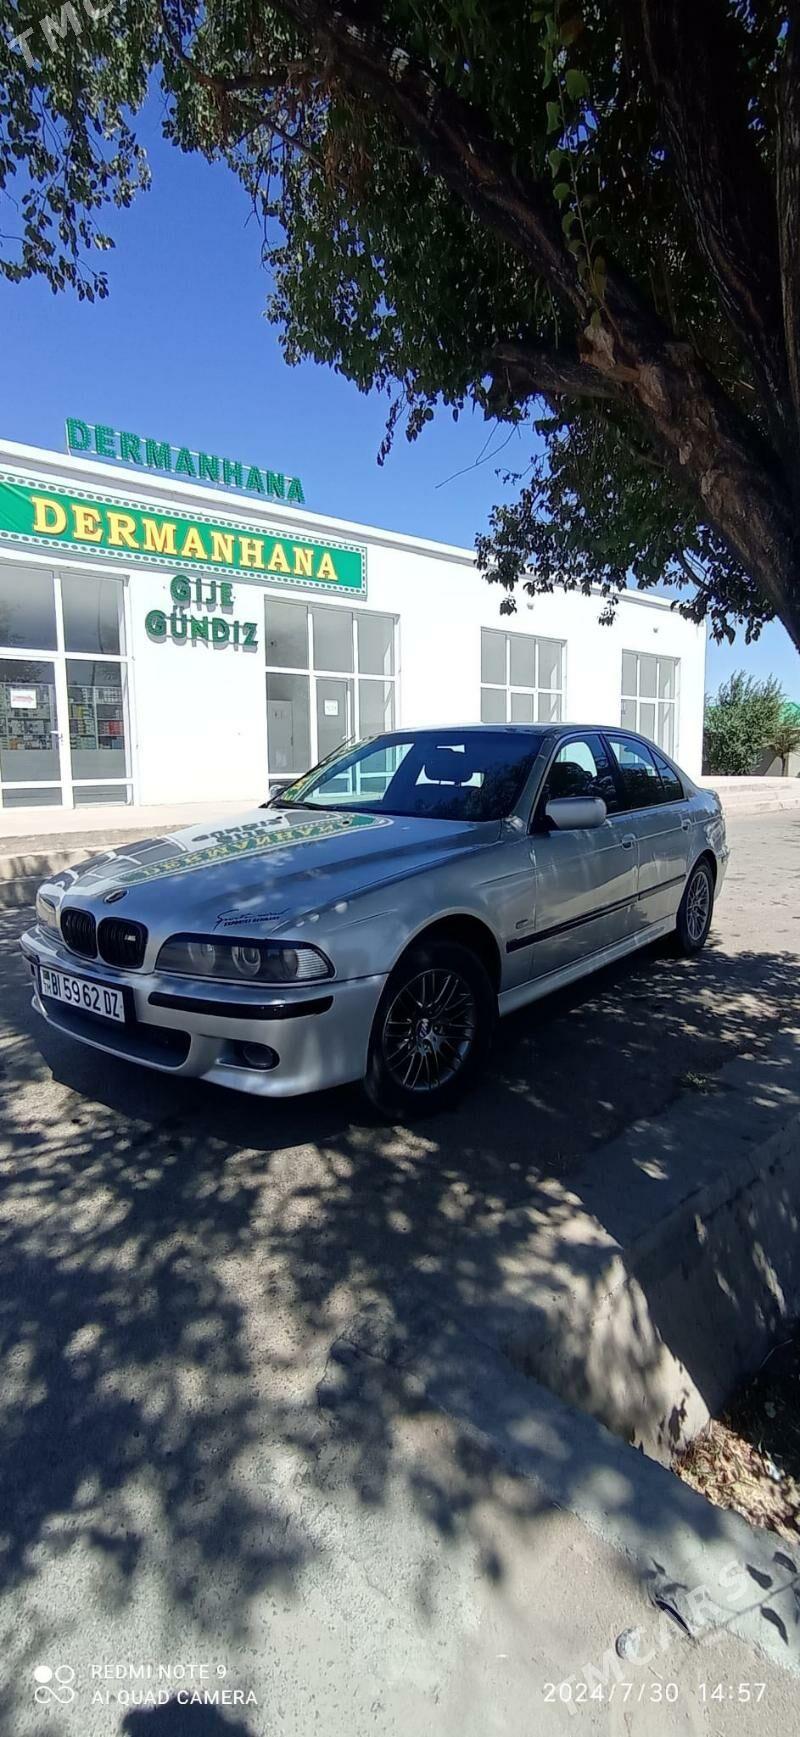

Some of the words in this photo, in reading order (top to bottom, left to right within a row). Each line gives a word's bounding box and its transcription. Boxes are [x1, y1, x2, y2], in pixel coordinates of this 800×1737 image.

[65, 417, 306, 505] DERMANHANA
[31, 495, 340, 582] DERMANHANA
[169, 574, 235, 608] GIJE
[51, 973, 61, 997] BI
[63, 977, 80, 1003] 59
[83, 984, 101, 1011] 62
[103, 990, 120, 1018] DZ
